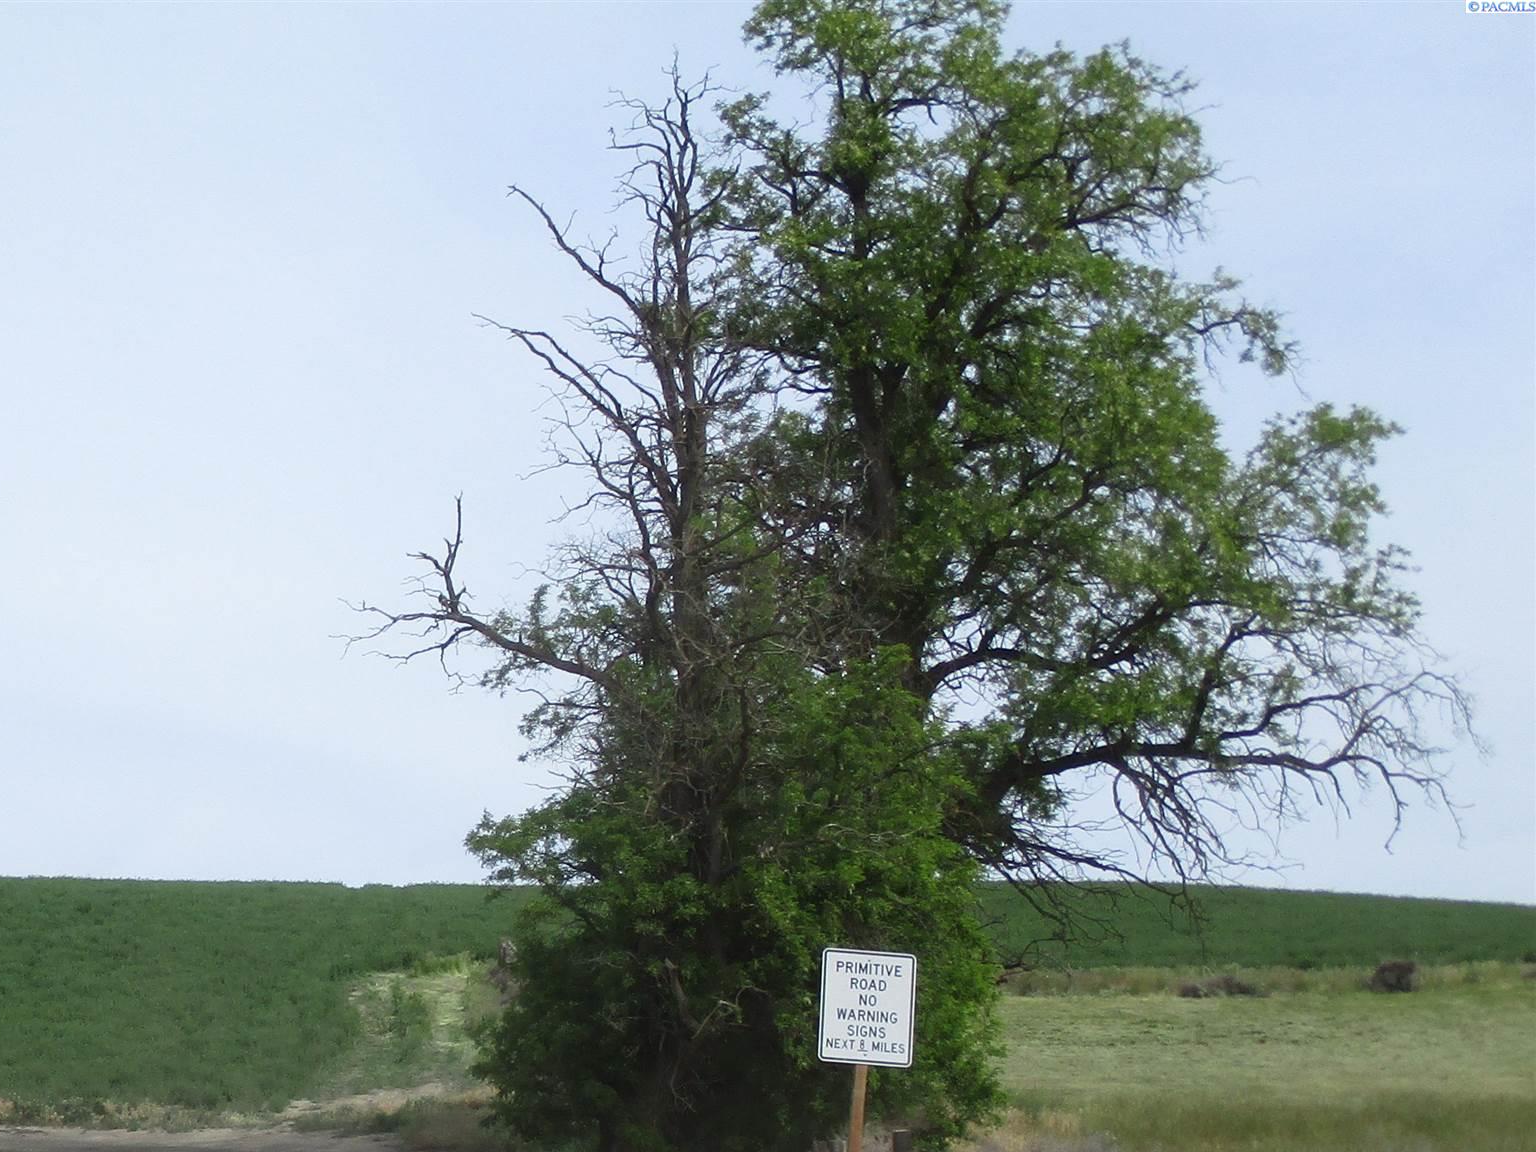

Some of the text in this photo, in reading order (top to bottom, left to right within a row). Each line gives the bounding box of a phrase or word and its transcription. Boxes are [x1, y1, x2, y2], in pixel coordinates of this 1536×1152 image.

[836, 960, 903, 978] PRIMITIVE
[850, 977, 887, 992] ROAD
[858, 994, 877, 1007] NO
[836, 1007, 898, 1024] WARNING
[847, 1024, 886, 1039] SIGNS
[825, 1038, 855, 1050] NEXT
[871, 1041, 905, 1054] MILES
